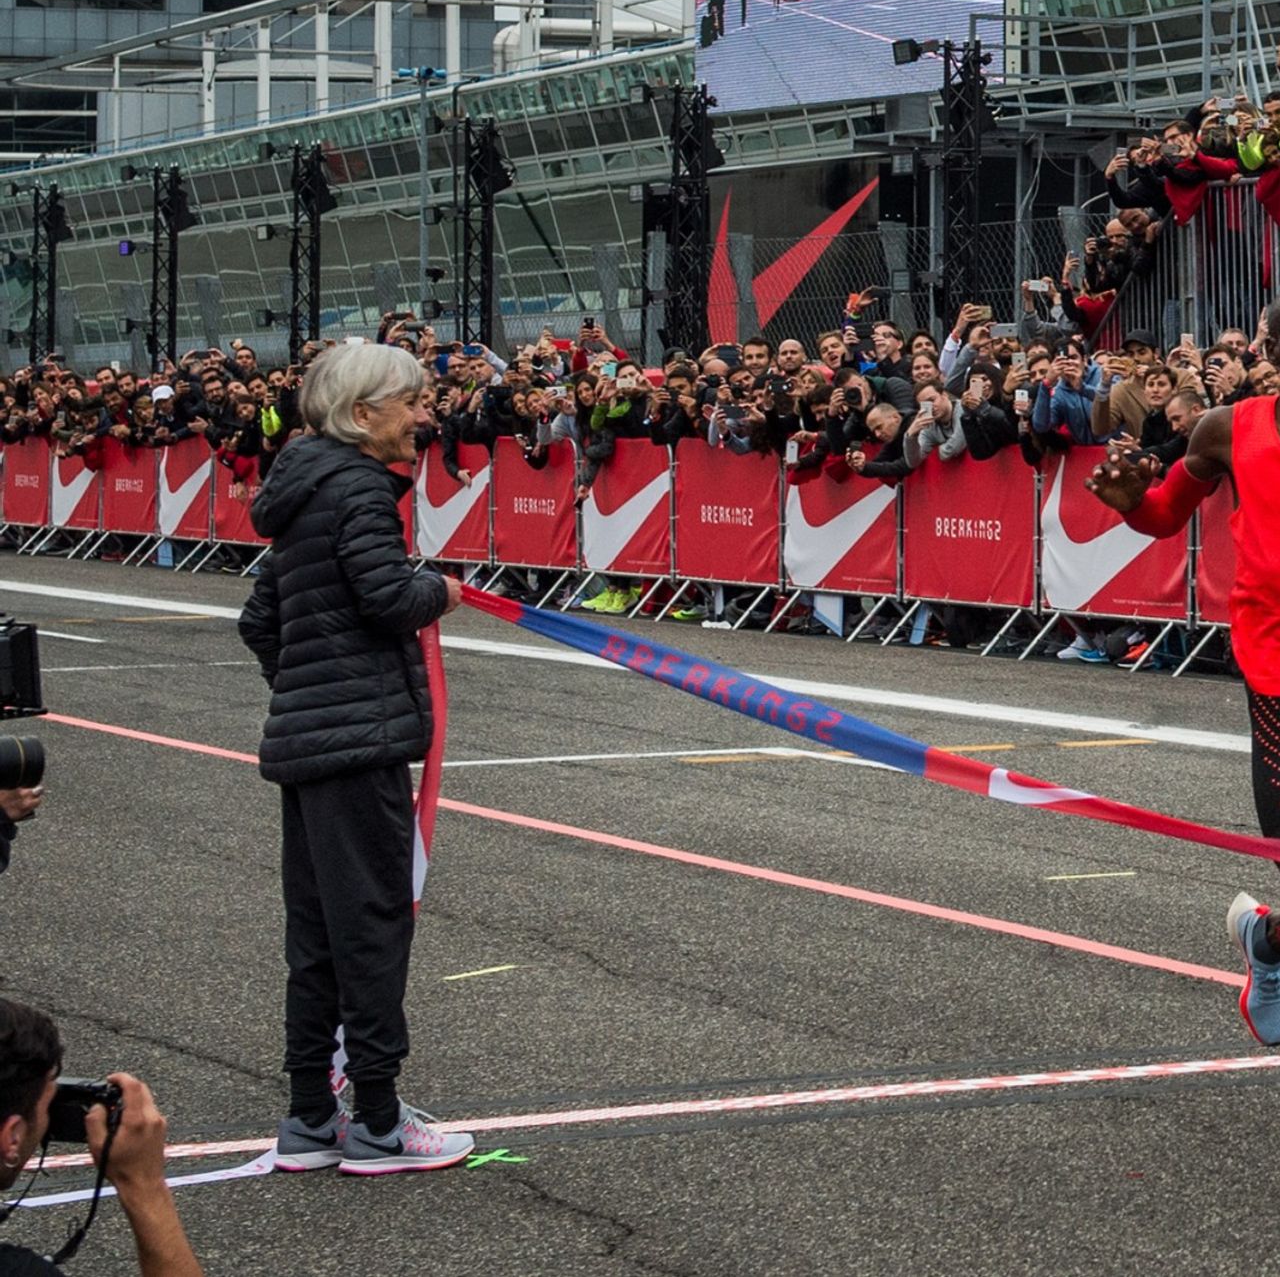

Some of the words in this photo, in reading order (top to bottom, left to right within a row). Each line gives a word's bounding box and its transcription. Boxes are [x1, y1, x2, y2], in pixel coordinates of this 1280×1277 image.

[513, 496, 556, 516] BREAKING2
[700, 504, 754, 527] BREAKING2
[935, 517, 1002, 541] BREAKING2
